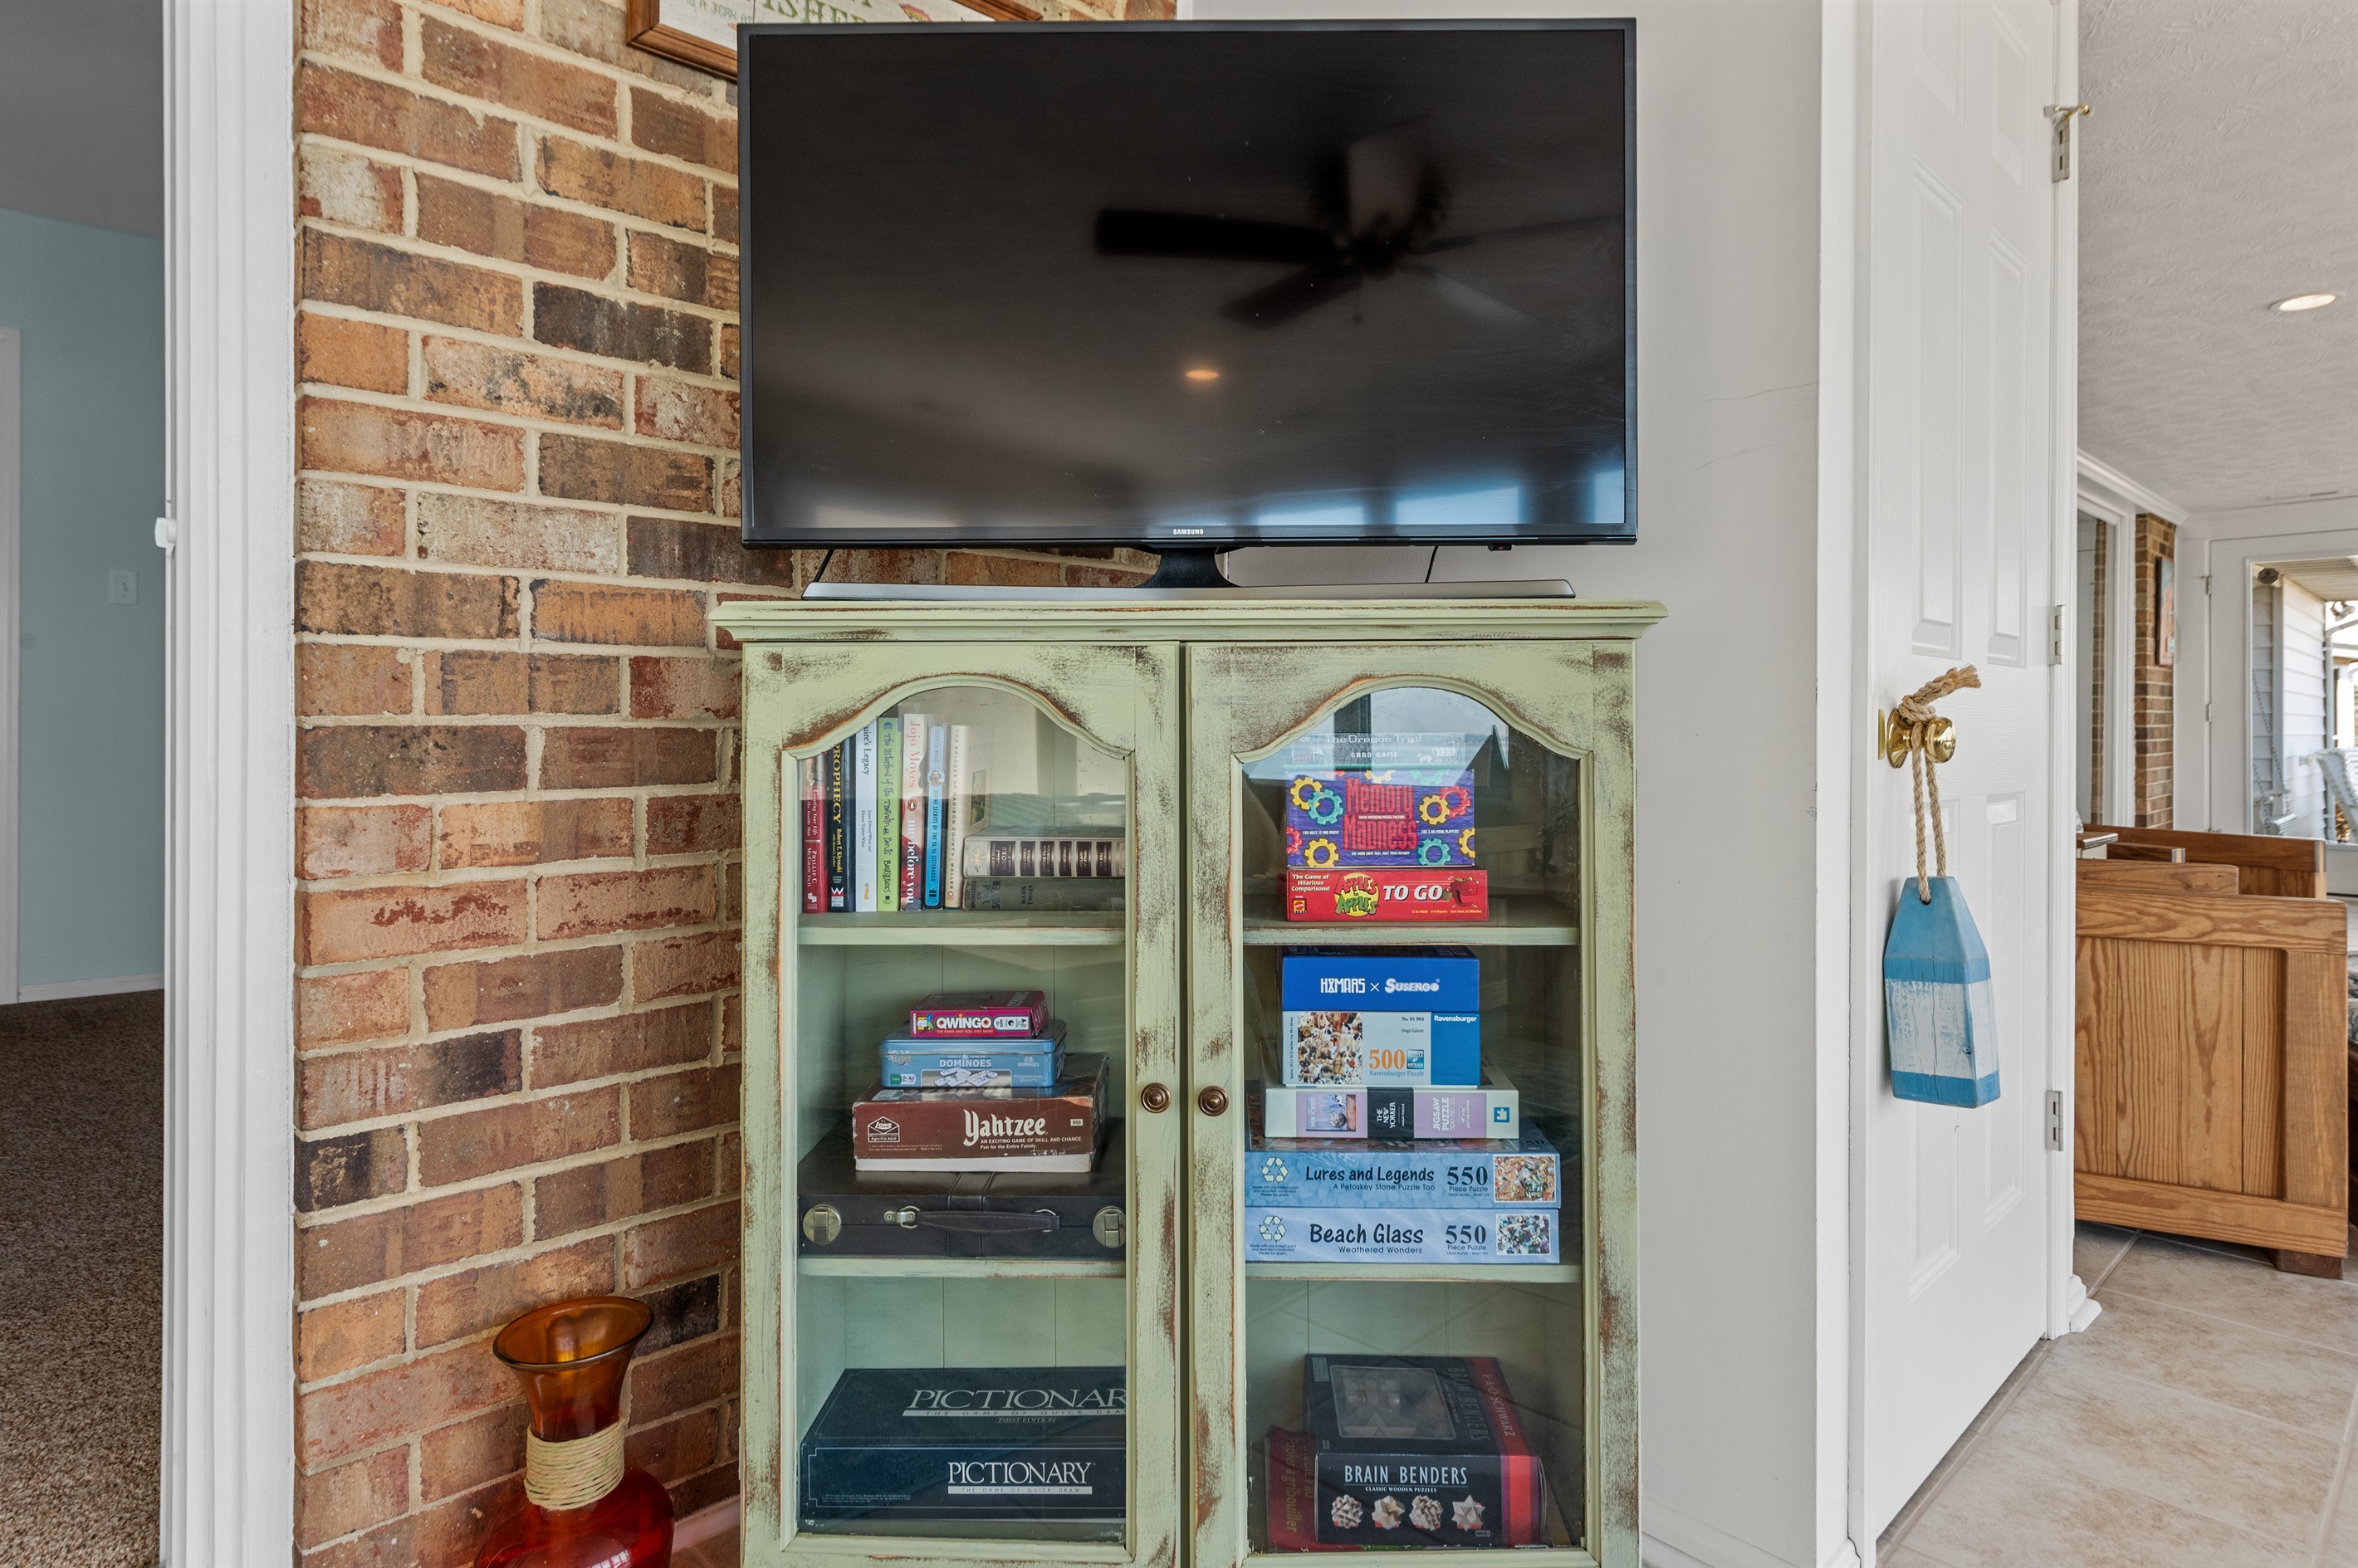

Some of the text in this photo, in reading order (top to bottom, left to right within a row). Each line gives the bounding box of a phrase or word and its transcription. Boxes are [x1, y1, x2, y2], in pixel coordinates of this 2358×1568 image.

[884, 734, 894, 746] The
[1348, 735, 1391, 744] Oregon
[1395, 735, 1421, 743] Trail
[862, 749, 871, 775] Legacy
[906, 720, 921, 788] Jojo Moyes
[884, 787, 894, 797] the
[1345, 778, 1415, 820] Memory
[883, 838, 894, 855] Pants
[903, 820, 918, 903] me before you
[1334, 873, 1378, 895] APPLES
[1382, 885, 1443, 901] TO GO
[1334, 894, 1378, 915] APPLES
[937, 1014, 991, 1029] QWINGO
[1434, 1015, 1477, 1023] Ravensburger
[939, 1059, 991, 1067] DOMINOES
[1368, 1049, 1406, 1070] 500
[1432, 1097, 1441, 1131] JIGSAW
[1441, 1097, 1450, 1131] PUZZLE
[963, 1109, 1046, 1146] Yahtzee
[1306, 1166, 1434, 1185] Lures and Legends
[1447, 1166, 1488, 1185] 550
[1310, 1223, 1423, 1243] Beach Glass
[1446, 1225, 1486, 1244] 550
[1282, 1437, 1299, 1467] Papier
[948, 1462, 1092, 1484] PICTIONARY
[1345, 1465, 1467, 1485] BRAIN BENDERS
[1281, 1475, 1302, 1532] gribouiller
